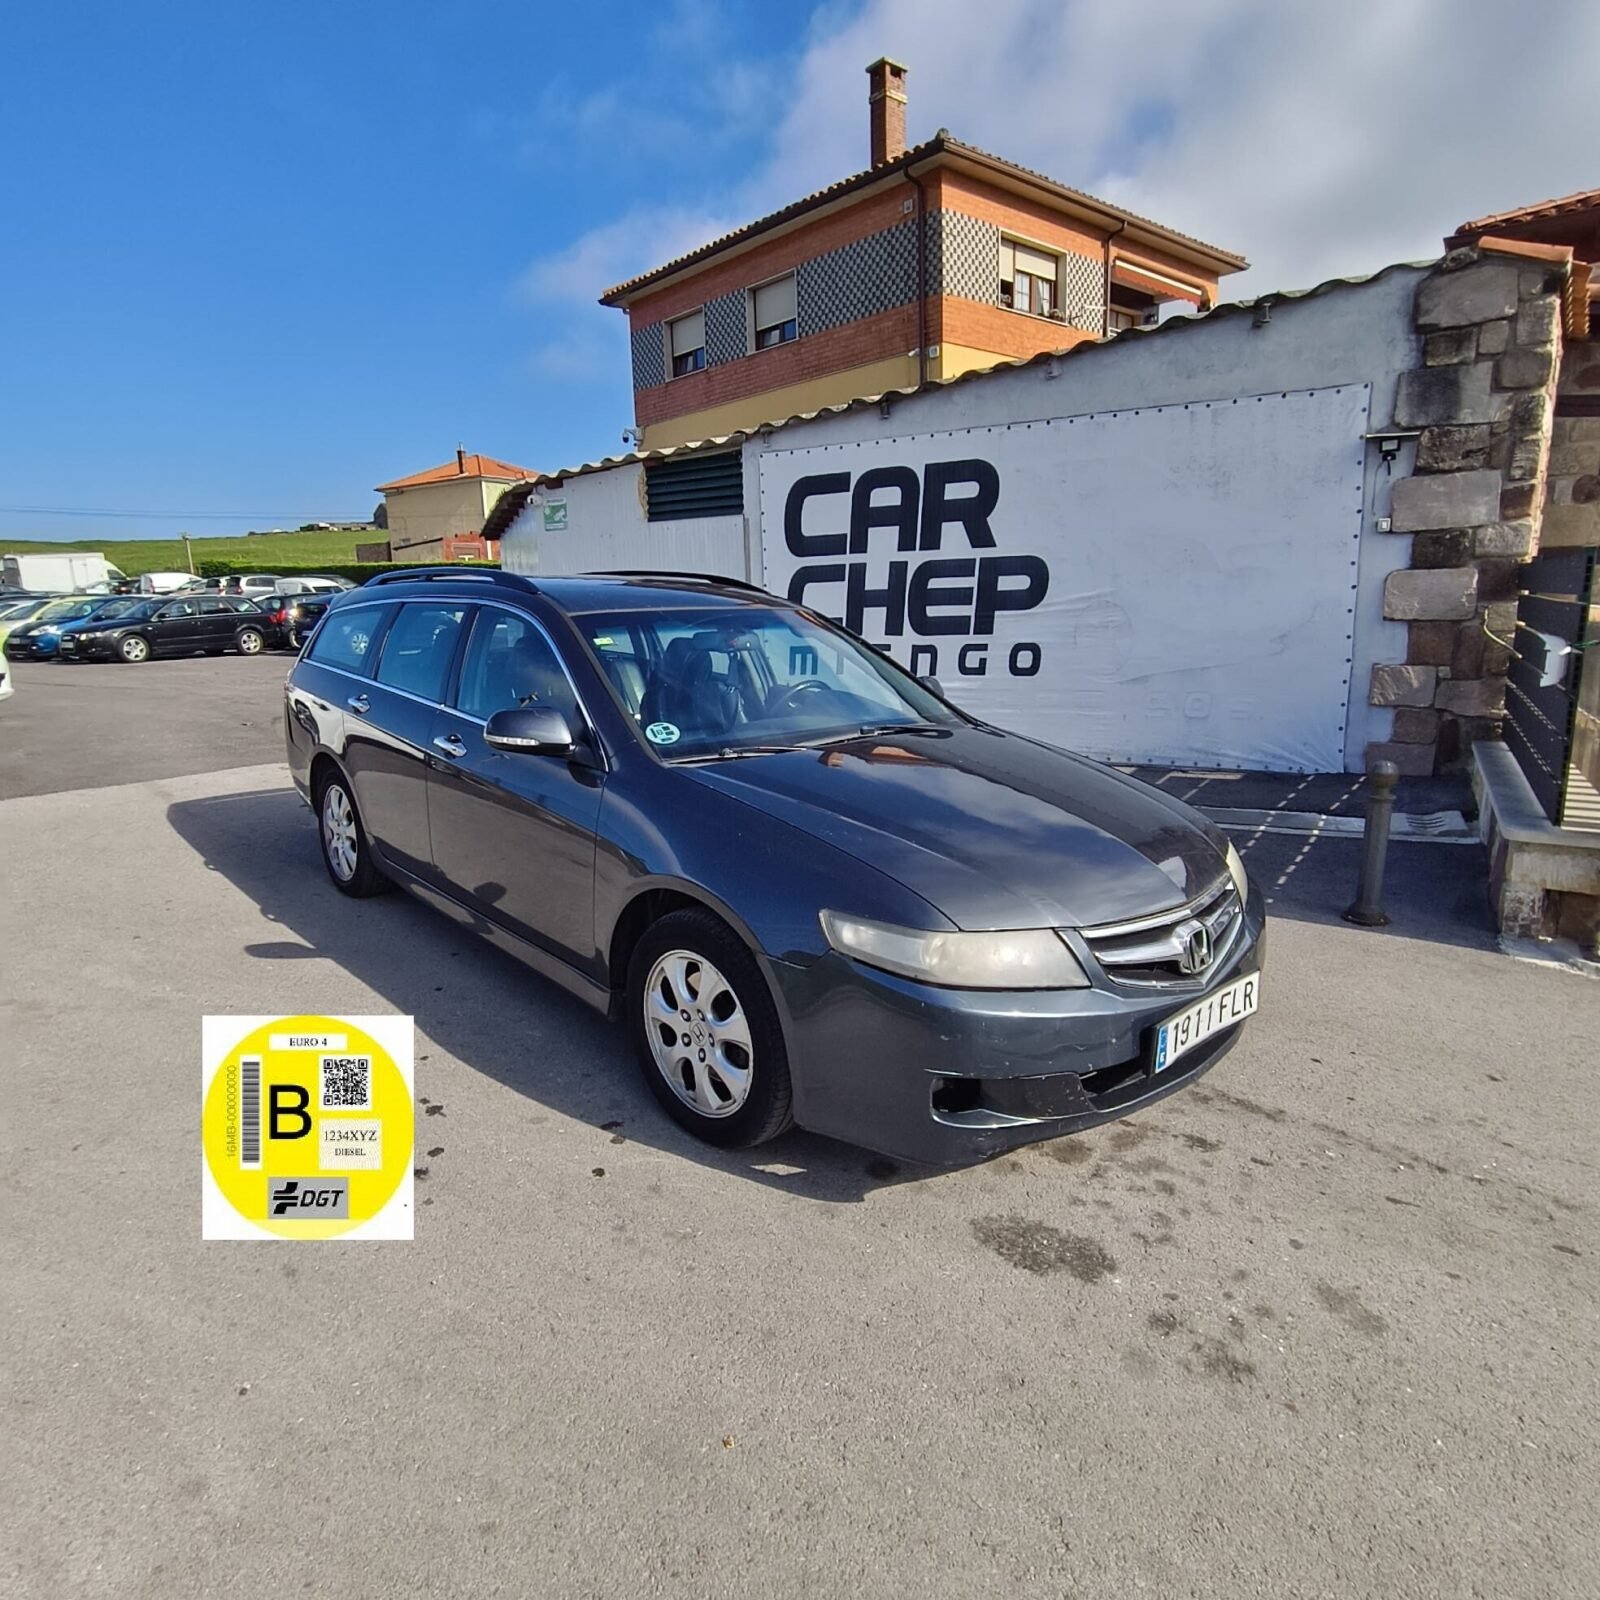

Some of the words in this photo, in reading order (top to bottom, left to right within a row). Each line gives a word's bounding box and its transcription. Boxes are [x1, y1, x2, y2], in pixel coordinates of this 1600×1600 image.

[784, 458, 1000, 558] CAR
[787, 555, 1050, 637] CHEP
[789, 642, 1042, 677] MINGO
[1219, 980, 1254, 1024] FLR
